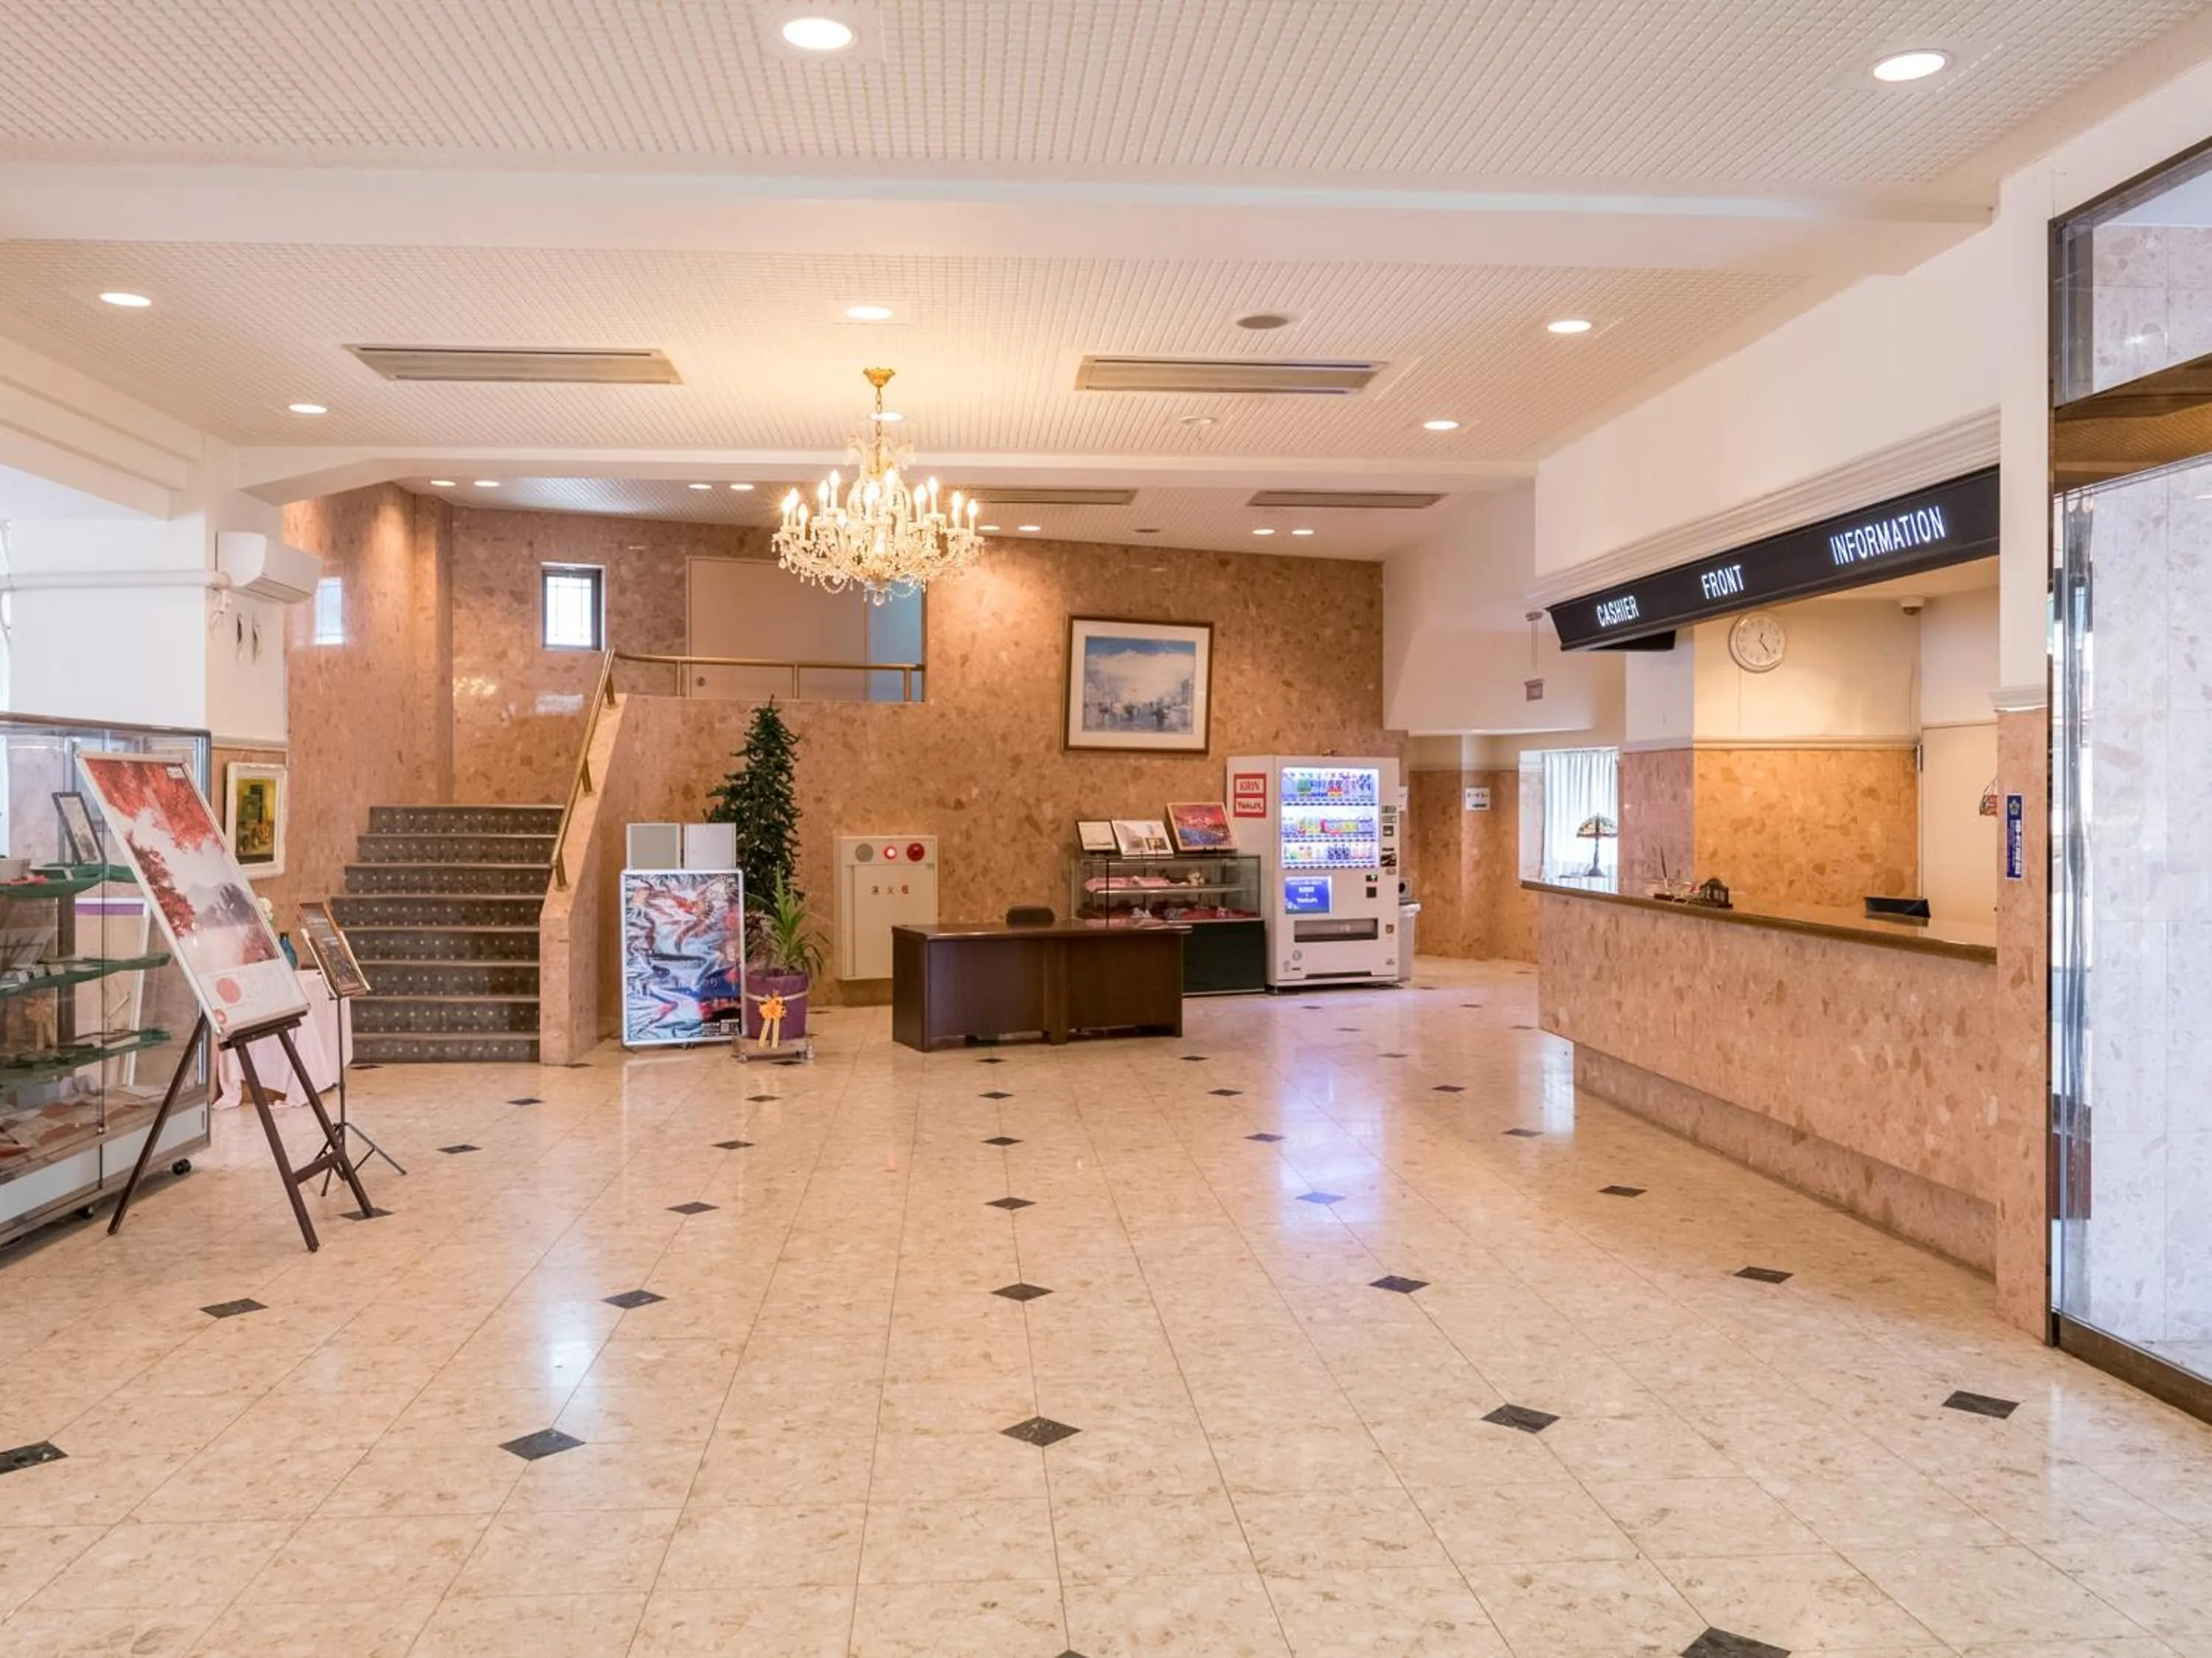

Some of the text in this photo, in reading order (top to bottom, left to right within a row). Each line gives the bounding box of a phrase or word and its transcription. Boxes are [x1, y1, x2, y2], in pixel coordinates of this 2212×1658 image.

[1829, 505, 1947, 566] INFORMATION
[1701, 564, 1745, 600] FRONT
[1596, 595, 1641, 628] CASHIER
